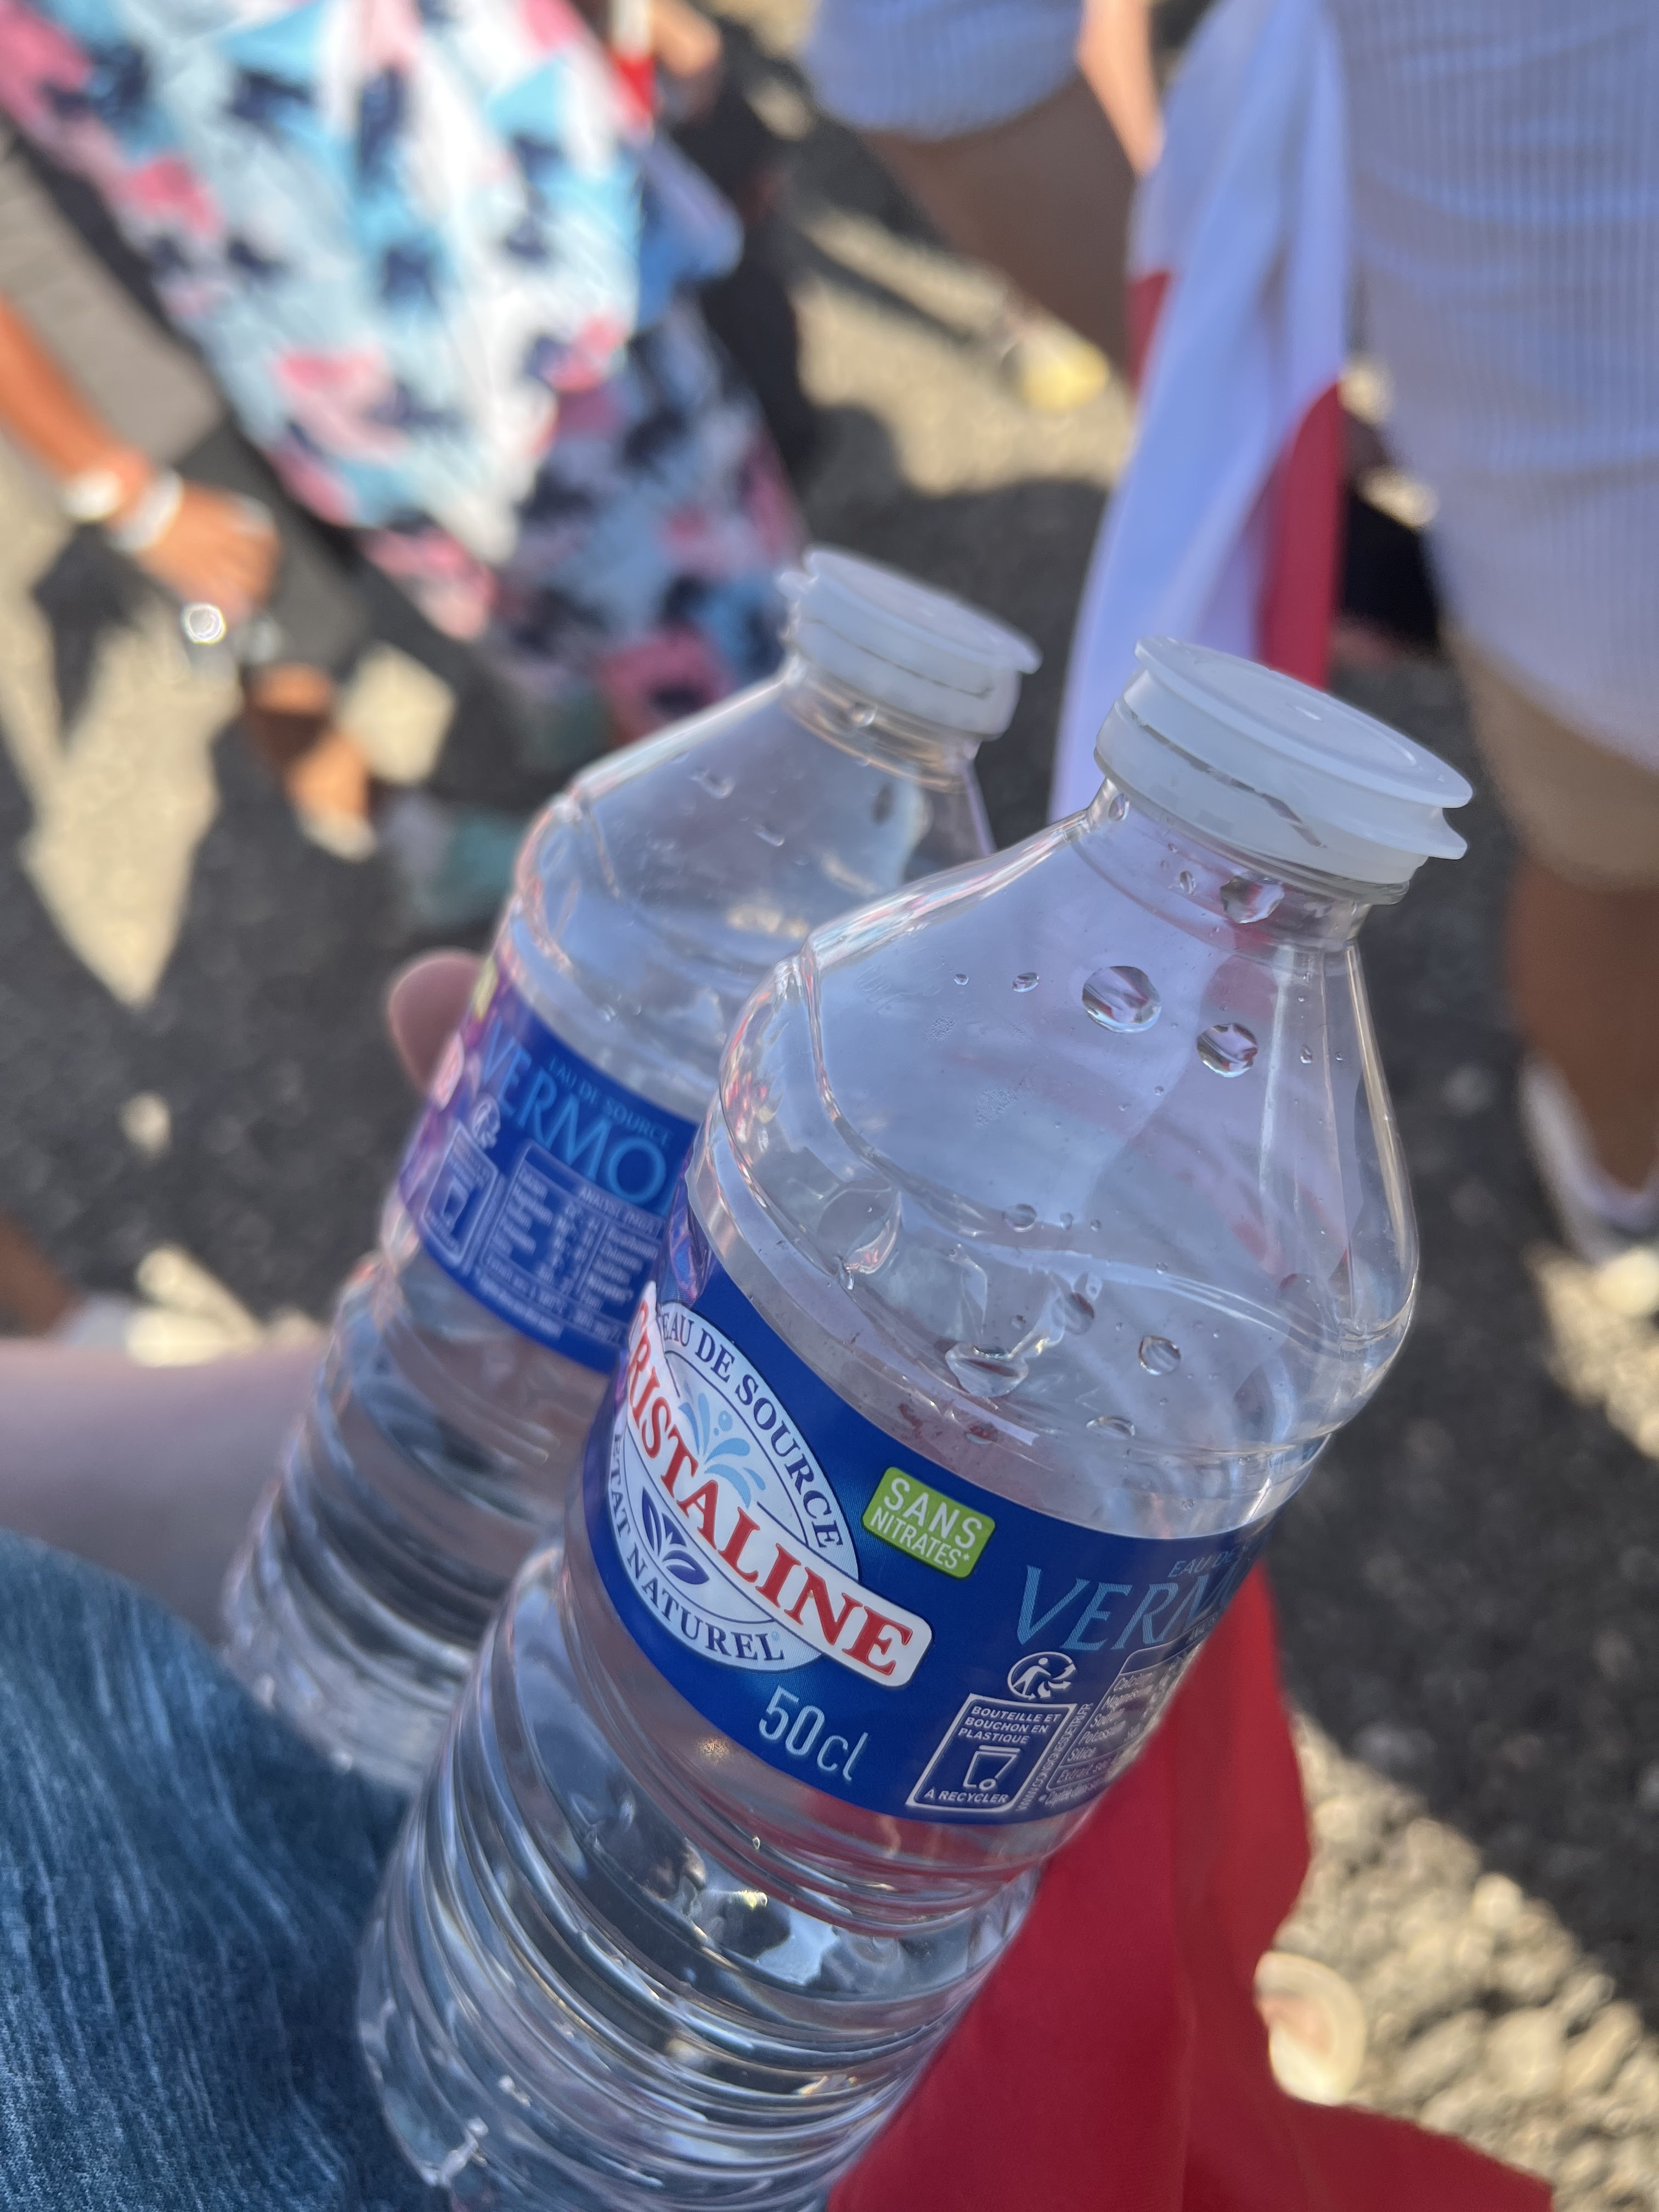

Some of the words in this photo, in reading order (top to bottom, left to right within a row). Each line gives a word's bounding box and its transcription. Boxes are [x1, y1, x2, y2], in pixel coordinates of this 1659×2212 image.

[662, 1312, 695, 1347] EAU
[694, 1328, 736, 1383] DE
[735, 1375, 843, 1548] SOURCE
[884, 1477, 983, 1549] SANS
[1167, 1554, 1212, 1578] EAU
[627, 1542, 785, 1661] NATUREL
[970, 1705, 1042, 1723] BOUTEILLE
[1043, 1713, 1062, 1723] ET
[1089, 1707, 1125, 1729] Sodium
[958, 1728, 1030, 1744] PLASTIQUE
[964, 1717, 1031, 1733] BOUCHON
[1032, 1724, 1049, 1734] EN
[1077, 1720, 1126, 1745] Potassium
[1066, 1746, 1097, 1762] Silice
[938, 1789, 1009, 1803] RECYCLER
